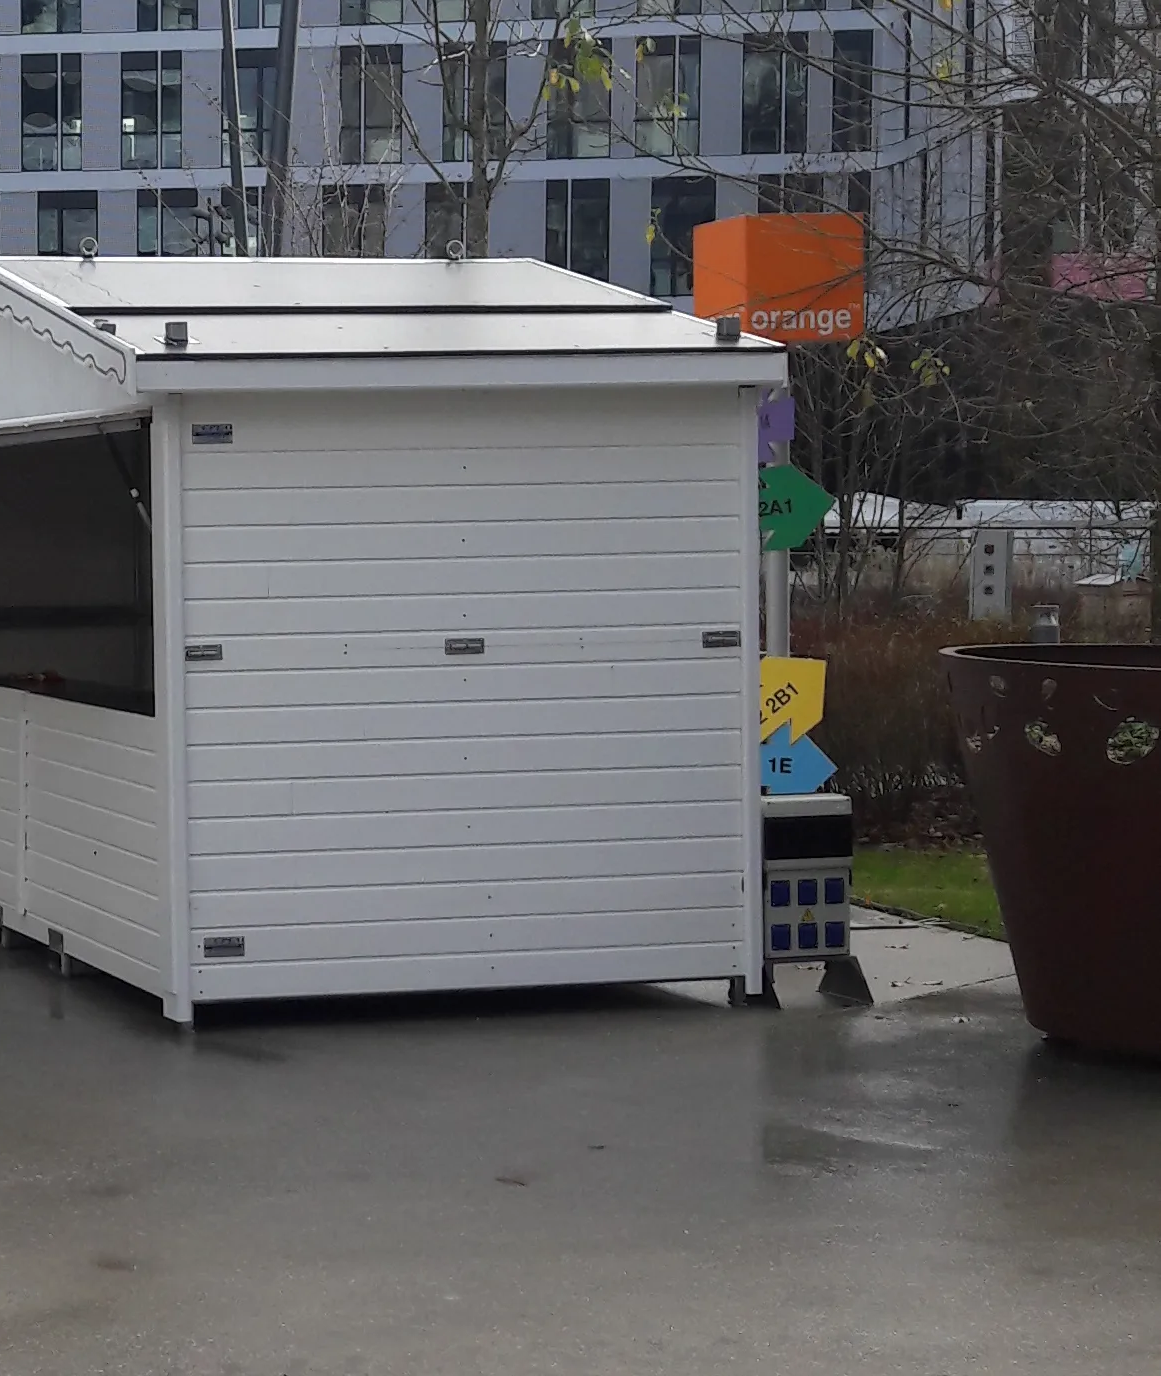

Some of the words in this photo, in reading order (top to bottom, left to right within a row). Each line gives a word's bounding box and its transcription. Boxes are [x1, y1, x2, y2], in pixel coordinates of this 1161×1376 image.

[751, 308, 852, 335] orange
[758, 498, 792, 517] 2A1
[765, 682, 799, 714] 2B1
[768, 757, 793, 774] 1E
